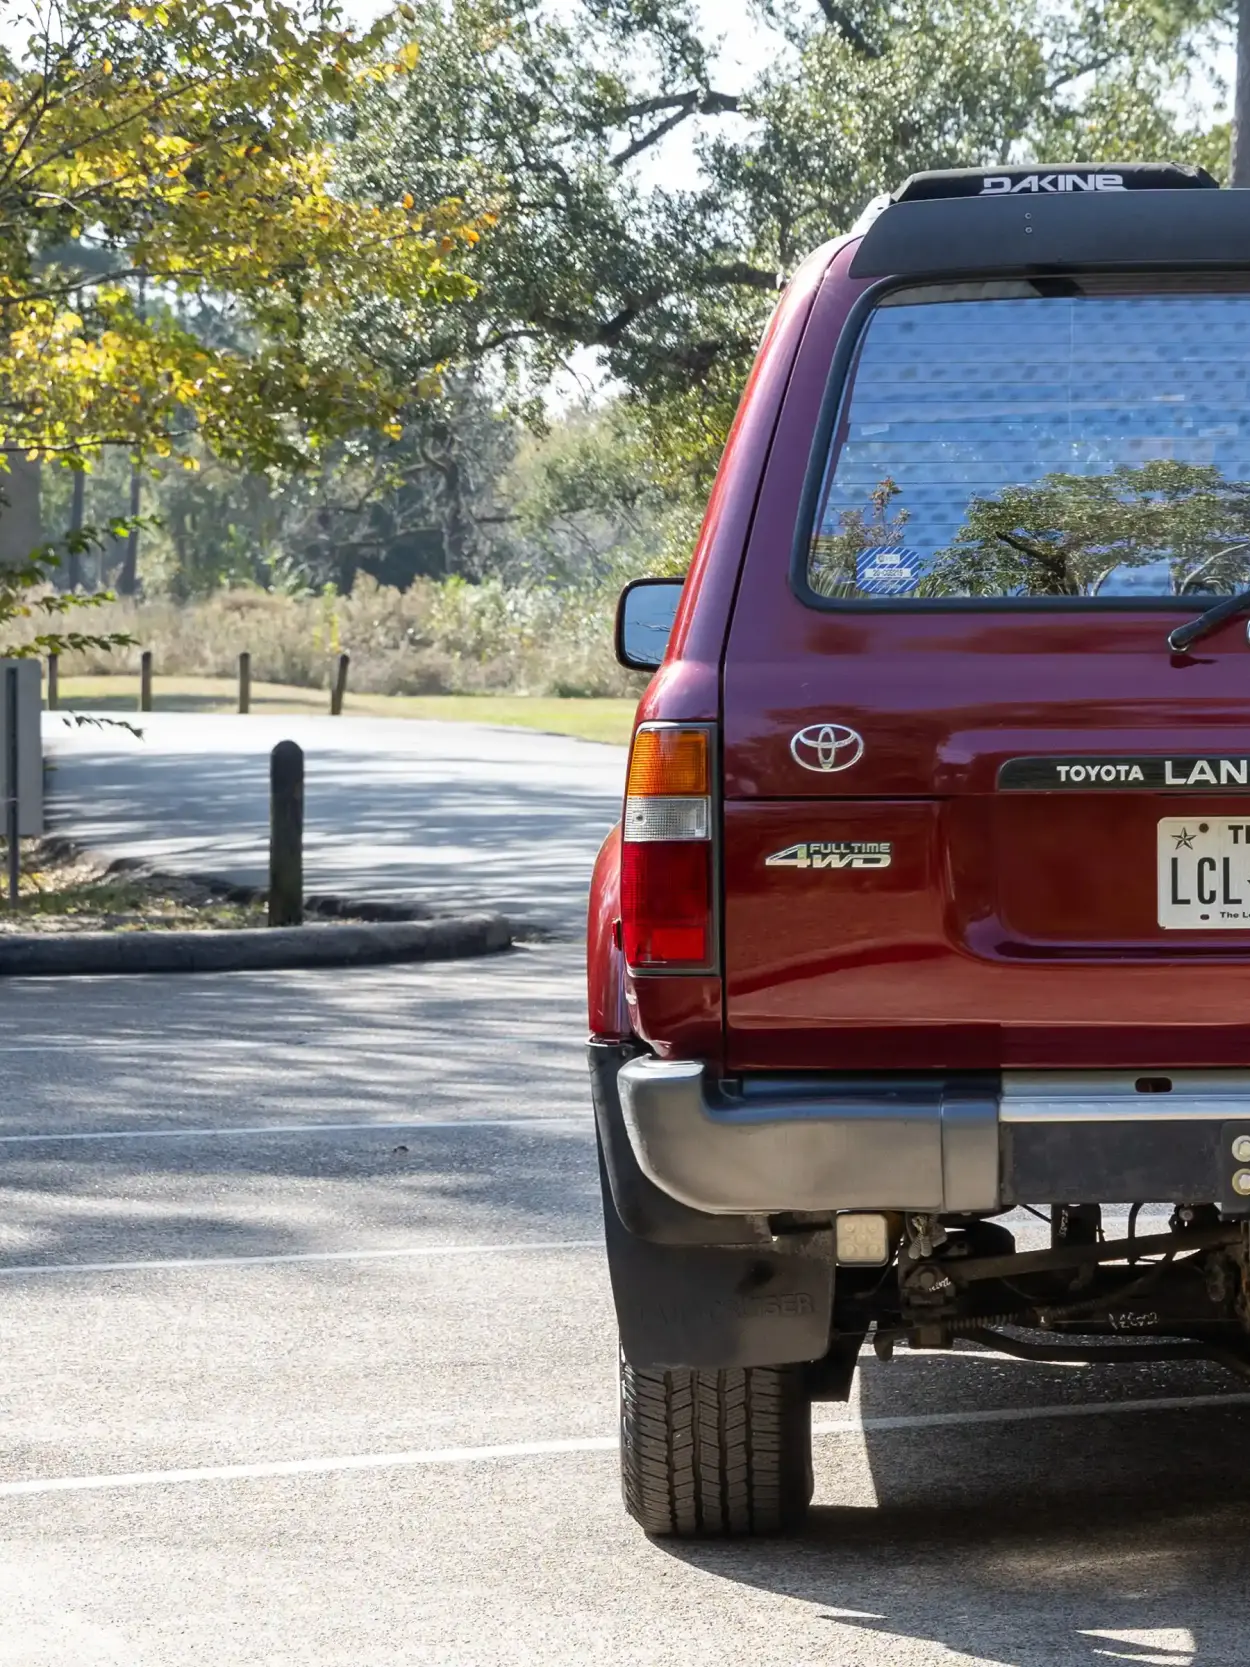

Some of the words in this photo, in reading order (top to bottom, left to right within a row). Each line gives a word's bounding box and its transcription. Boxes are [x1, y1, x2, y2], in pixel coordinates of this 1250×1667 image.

[979, 174, 1128, 195] DAKINE
[1056, 765, 1144, 782] TOYOTA
[765, 844, 892, 868] 4WD
[809, 842, 850, 854] FULL
[851, 842, 891, 853] TIME
[1219, 911, 1239, 919] The
